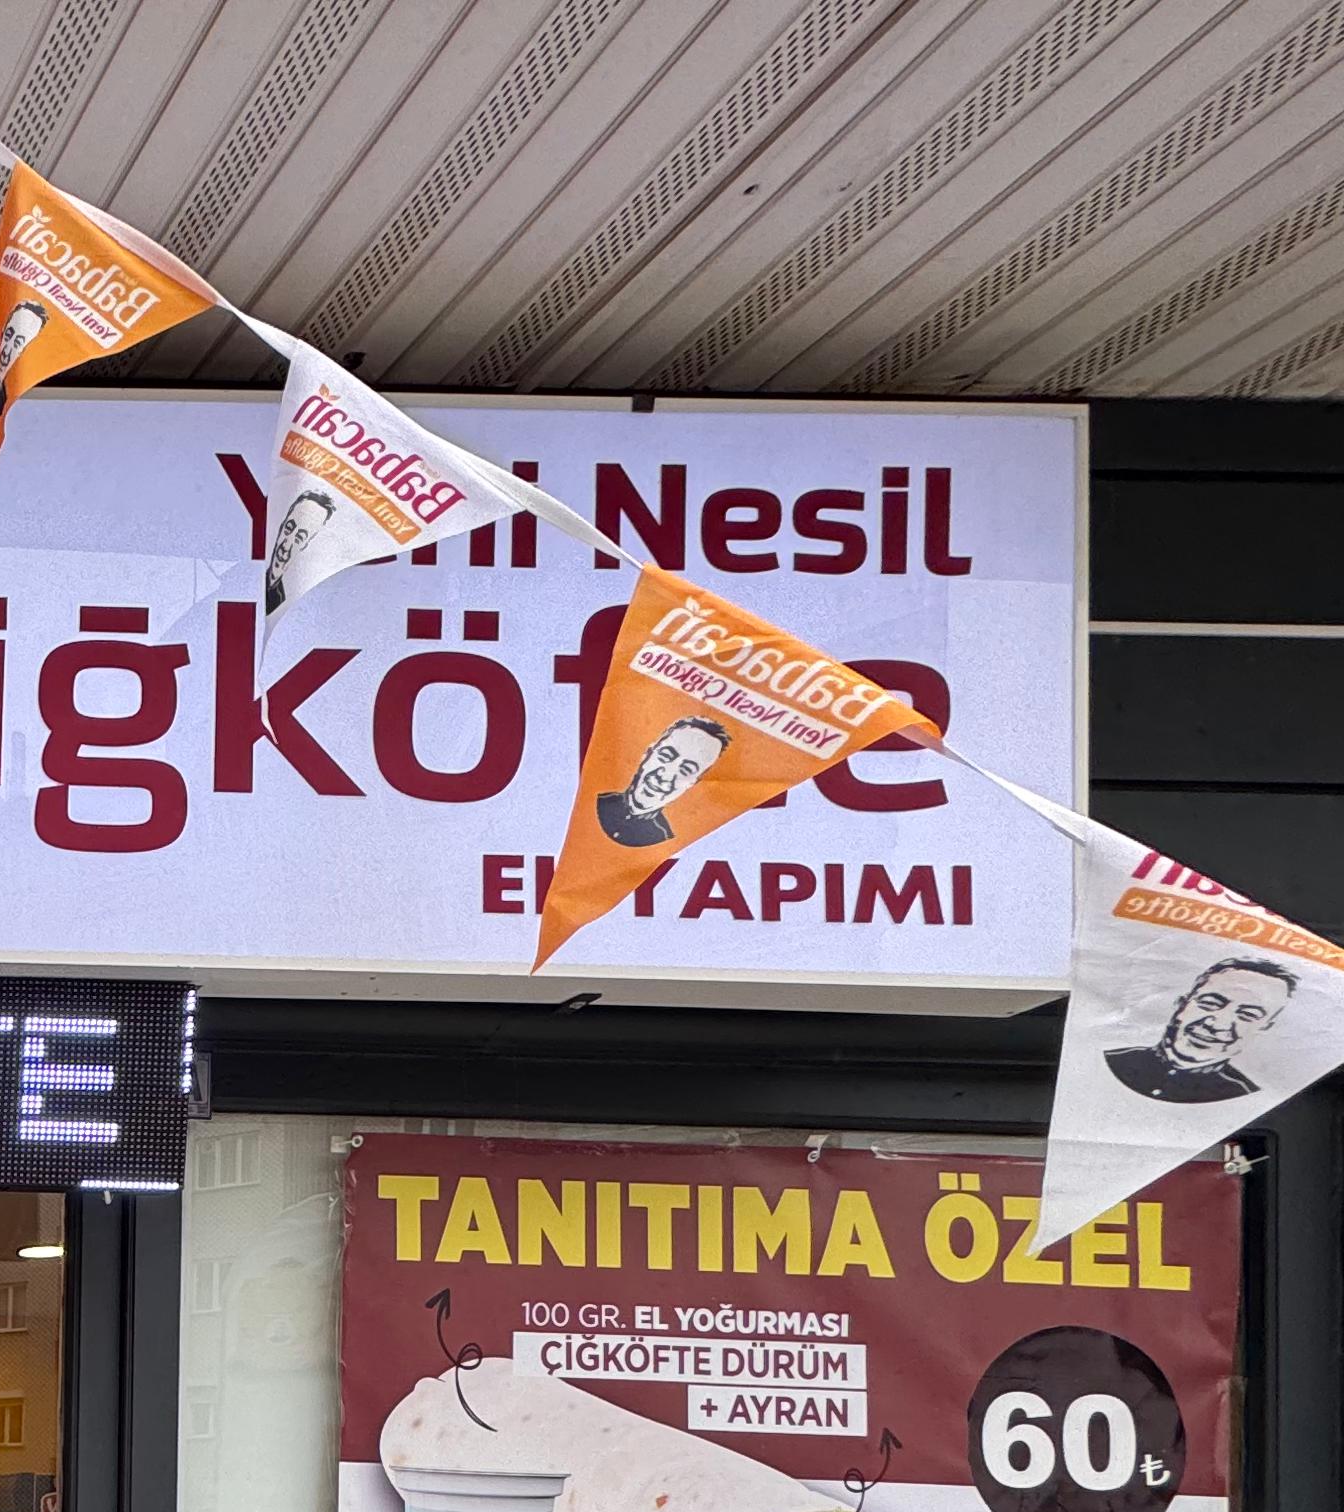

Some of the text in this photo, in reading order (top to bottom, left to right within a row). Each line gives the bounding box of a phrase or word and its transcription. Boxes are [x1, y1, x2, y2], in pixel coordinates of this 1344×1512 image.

[594, 462, 973, 578] Nesil
[634, 857, 973, 926] YAPIMI
[378, 1173, 1192, 1290] TANITIMA ÖZEL
[522, 1302, 849, 1337] 100 GR. EL YOĞURMASI
[541, 1334, 848, 1381] ÇİĞKÖFTE DÜRÜM
[728, 1395, 848, 1427] AYRAN
